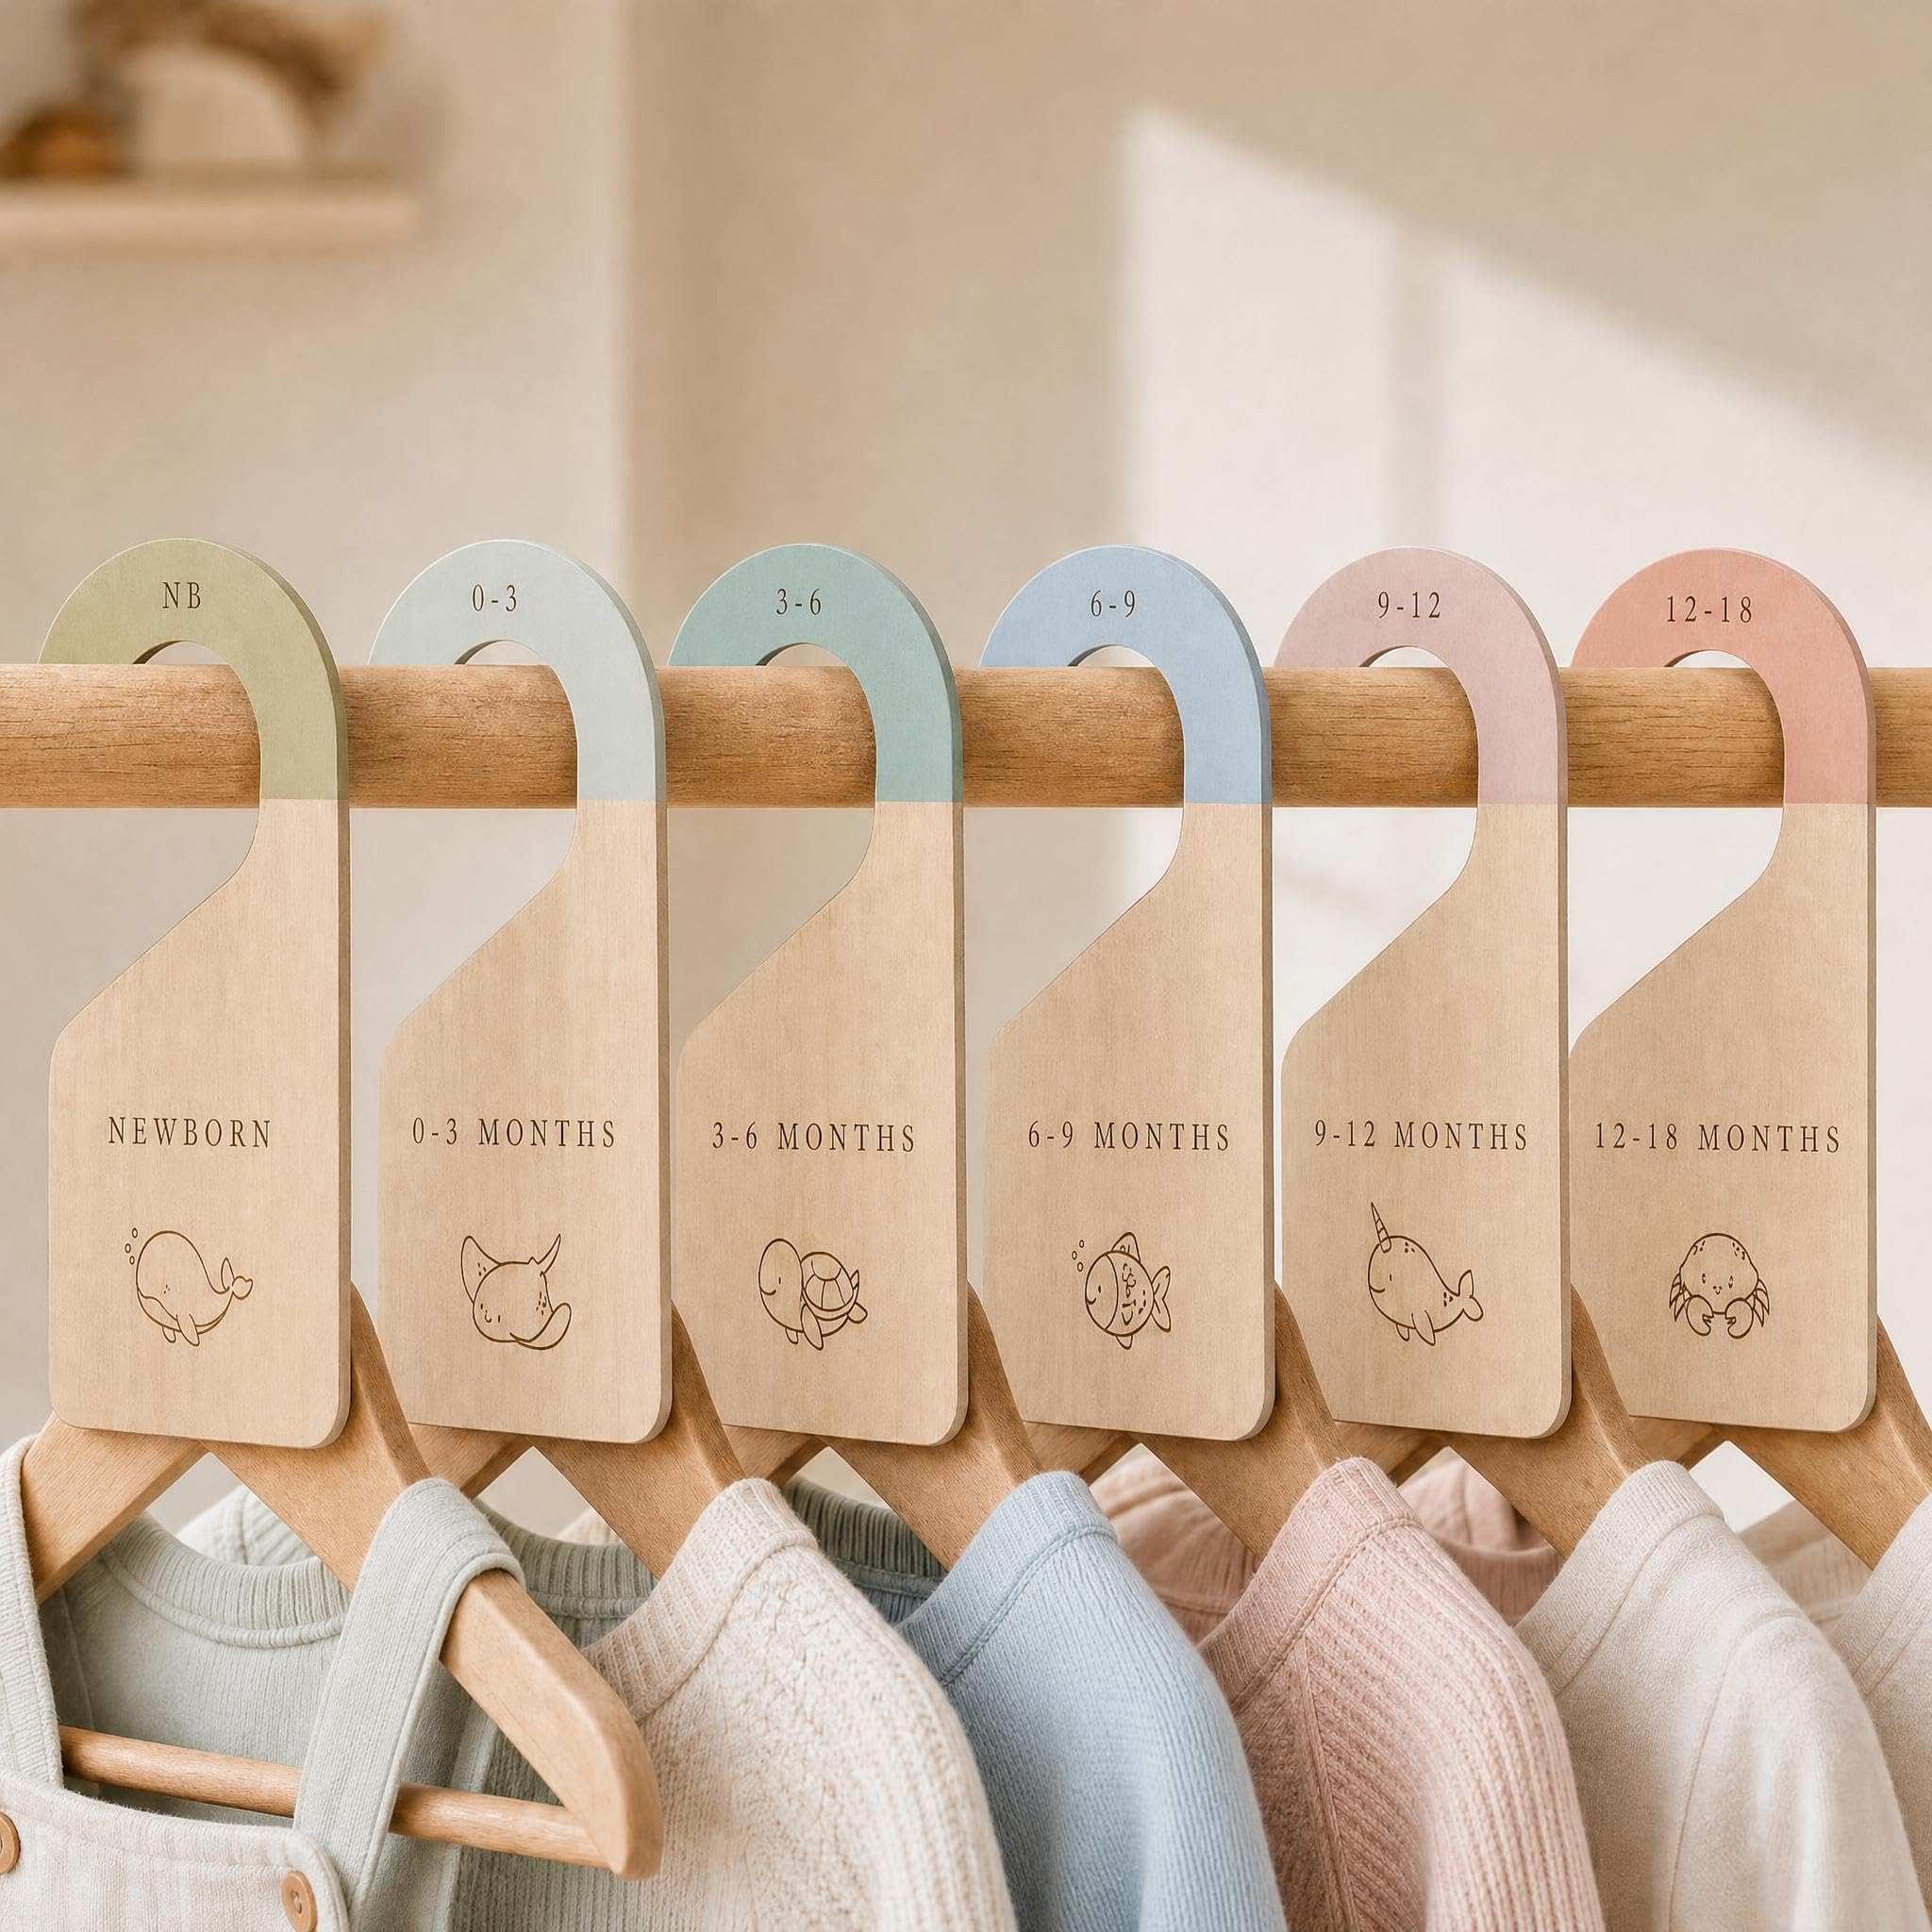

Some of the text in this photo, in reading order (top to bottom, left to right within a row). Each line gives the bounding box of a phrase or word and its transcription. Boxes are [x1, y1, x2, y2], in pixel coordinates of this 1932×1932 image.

[162, 582, 201, 609] NB
[472, 583, 517, 612] 0-3
[775, 588, 822, 615] 3-6
[1091, 590, 1136, 618] 6-9
[1377, 591, 1441, 619] 9-12
[1667, 595, 1752, 624] 12-18
[108, 1117, 270, 1148] NEWBORN
[412, 1117, 615, 1148] 0-3 MONTHS
[712, 1121, 914, 1153] 3-6 MONTHS
[1028, 1120, 1229, 1152] 6-9 MONTHS
[1314, 1119, 1526, 1151] 9-12 MONTHS
[1595, 1122, 1840, 1154] 12-18 MONTHS
